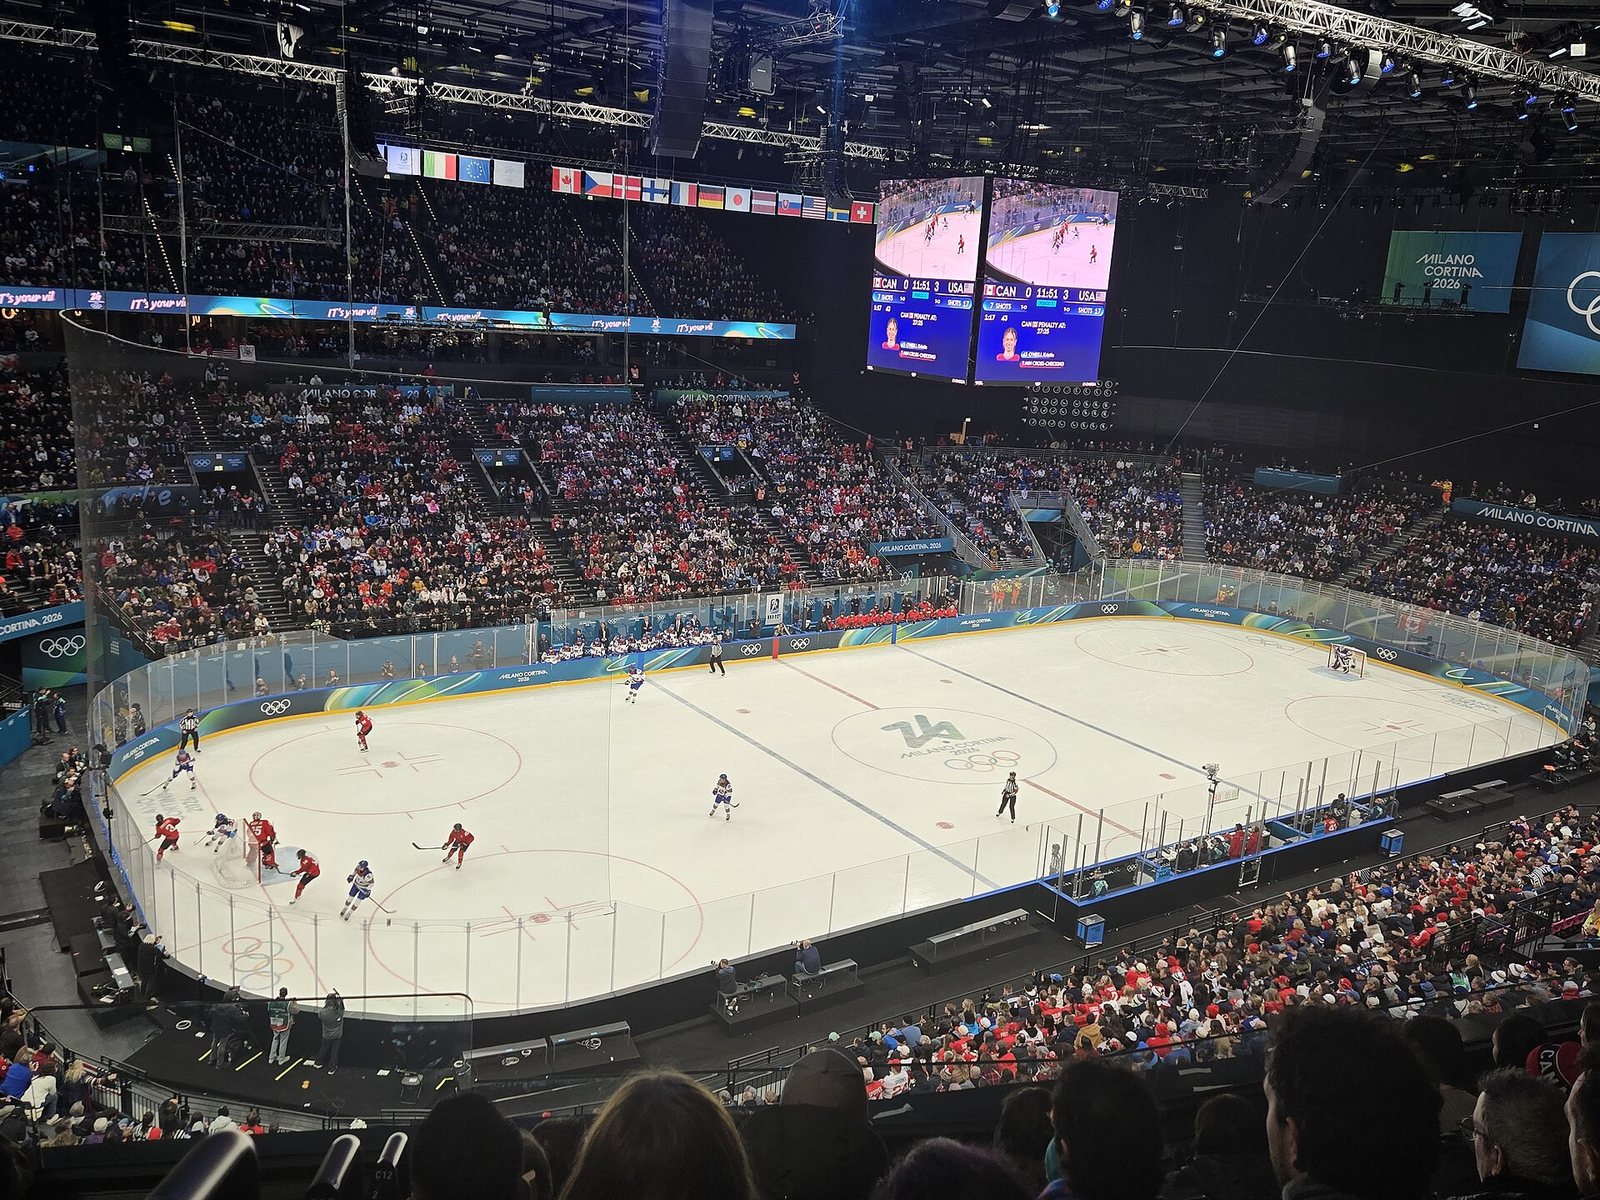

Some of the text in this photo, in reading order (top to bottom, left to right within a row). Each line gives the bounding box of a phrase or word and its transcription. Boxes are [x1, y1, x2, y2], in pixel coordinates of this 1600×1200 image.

[1416, 254, 1474, 264] MILANO
[1424, 266, 1484, 278] CORTINA
[882, 278, 964, 293] CAN 0 11:51 3 USA
[1433, 278, 1460, 289] 2026
[0, 292, 14, 304] T's
[14, 294, 41, 305] your
[996, 286, 1096, 301] CAN 0 11:51 3 USA
[130, 298, 149, 309] IT's
[149, 300, 175, 310] your
[328, 307, 344, 318] IT's
[1476, 507, 1599, 537] MILANO CORTINA
[0, 612, 63, 635] CORTINA 2026
[901, 736, 1014, 759] MILANO CORTINA
[950, 747, 980, 756] 2026
[376, 1170, 392, 1180] C12
